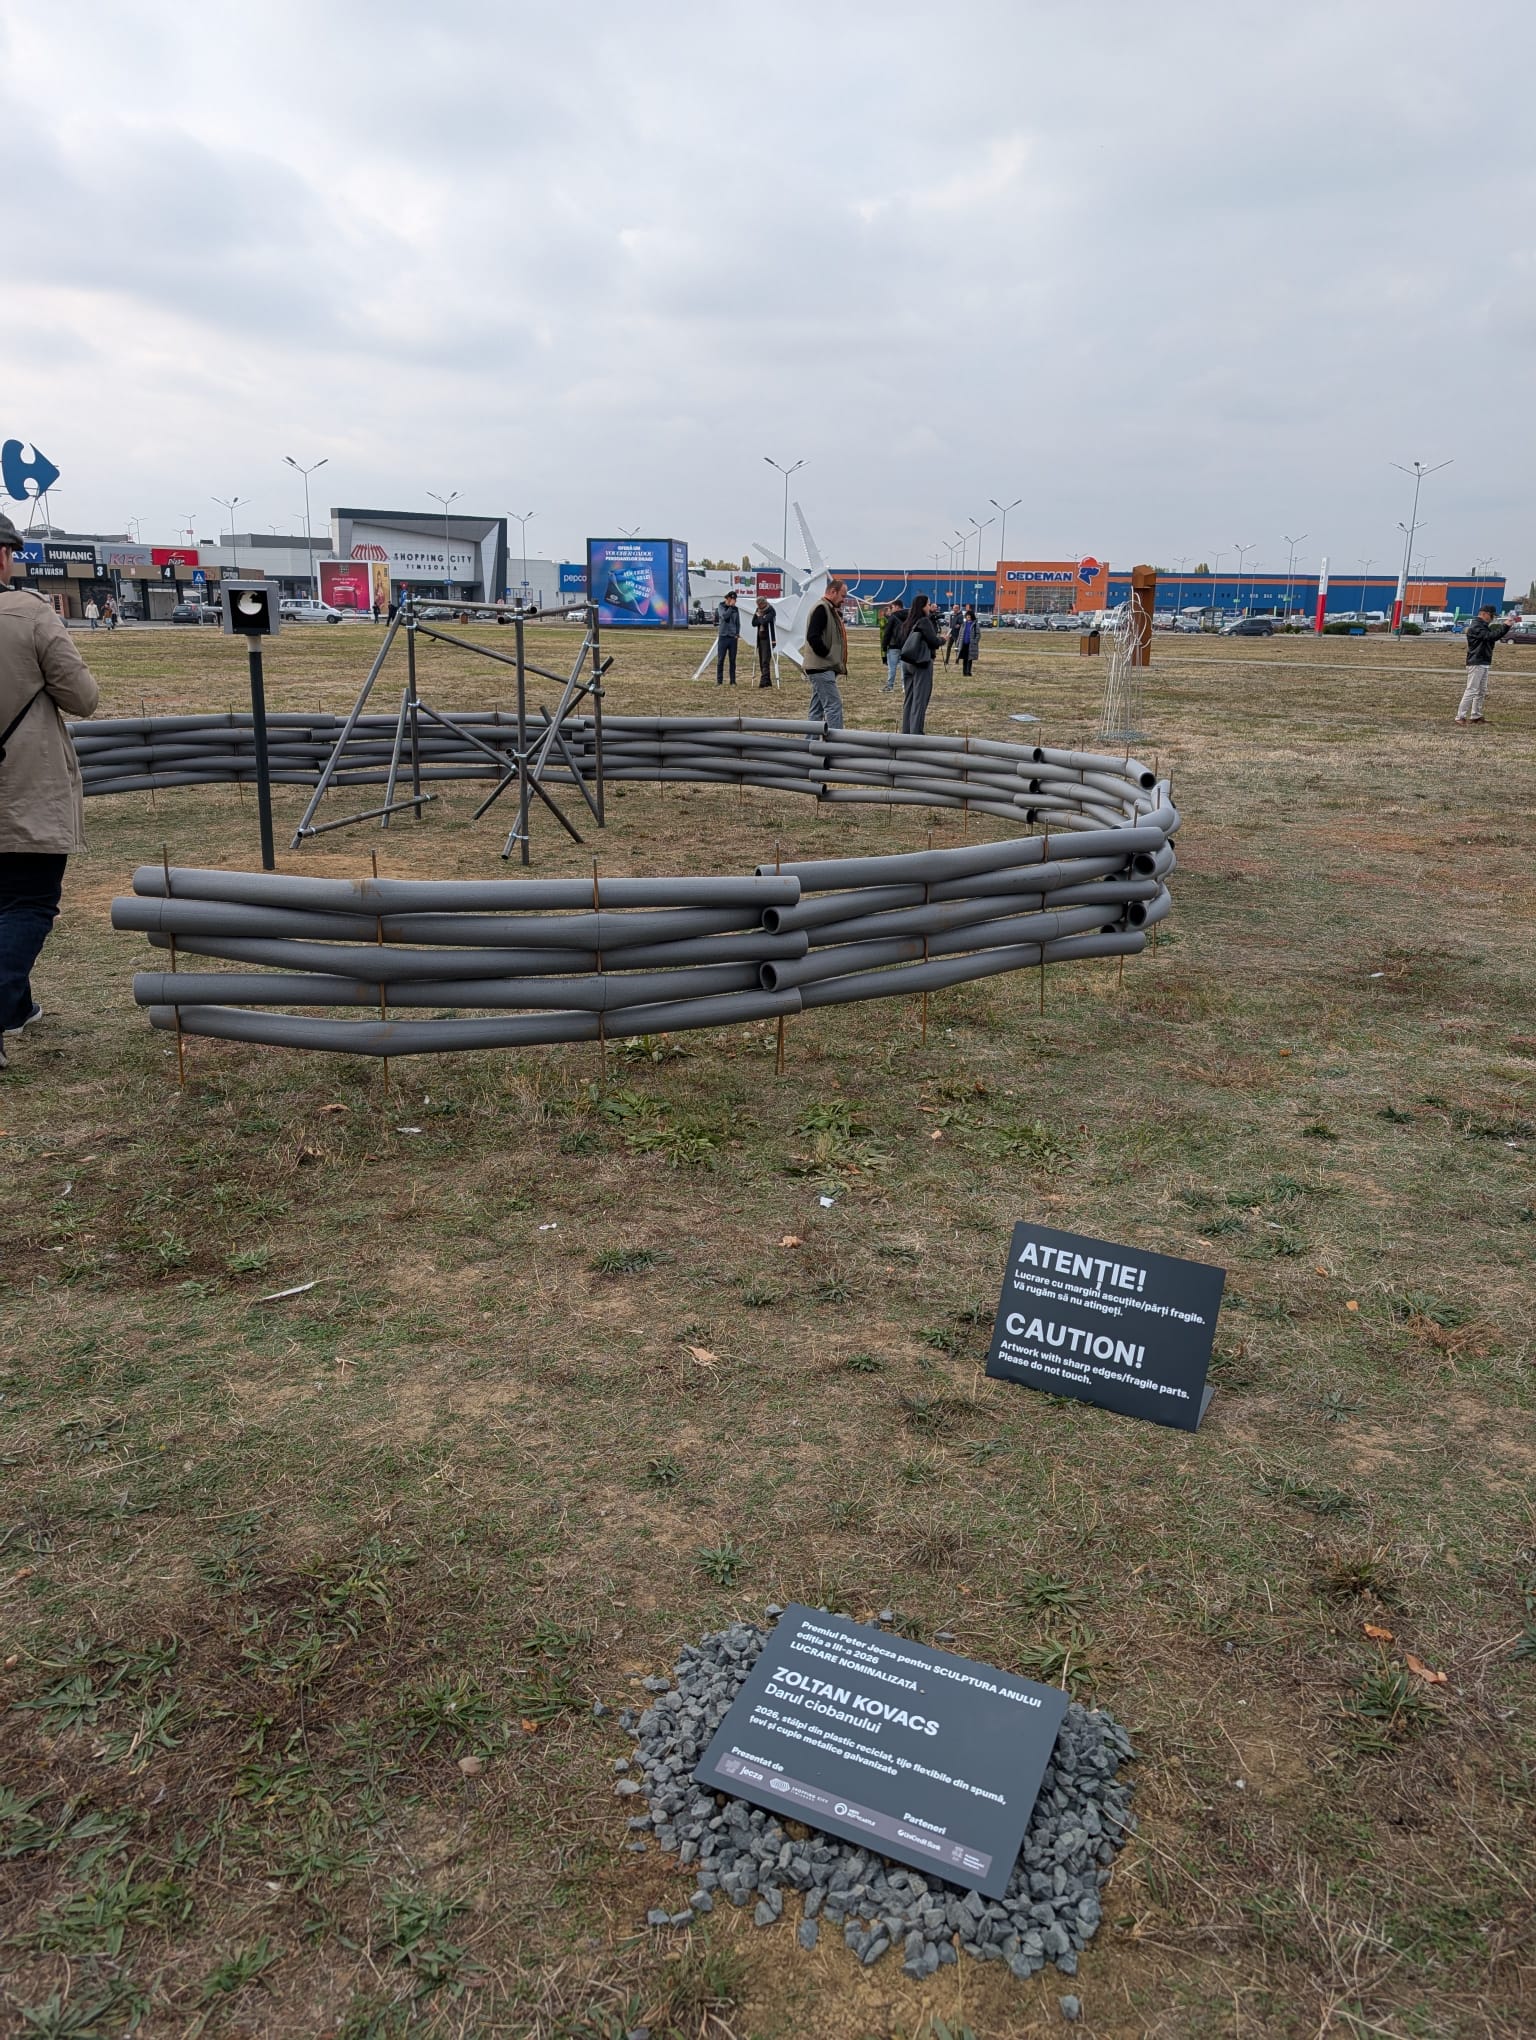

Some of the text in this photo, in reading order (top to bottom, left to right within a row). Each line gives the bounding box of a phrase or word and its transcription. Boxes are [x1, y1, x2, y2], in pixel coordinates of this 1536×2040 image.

[30, 567, 63, 576] CAR WASH
[49, 550, 93, 560] HUMANIC
[97, 566, 103, 576] 3
[164, 567, 170, 578] 4
[394, 553, 472, 564] SHOPPING CITY
[564, 574, 587, 583] pepco
[1006, 571, 1073, 581] DEDEMAN
[1018, 1242, 1147, 1292] ATENȚIE!
[1013, 1280, 1123, 1317] Vă rugăm să nu atingeți.
[1015, 1269, 1205, 1324] Lucrare cu margini ascuțite/părți fragile.
[1006, 1312, 1145, 1369] CAUTION!
[998, 1351, 1092, 1385] Please do not touch.
[1000, 1340, 1190, 1400] Artwork with sharp edges/fragile parts.
[797, 1631, 824, 1645] ediția
[832, 1643, 853, 1656] III-a
[853, 1650, 879, 1664] 2026
[801, 1621, 1042, 1708] Premiul Peter Jecza pentru SCULPTURA ANULUI
[790, 1641, 917, 1691] LUCRARE NOMINALIZATĂ
[765, 1683, 882, 1734] Darul ciobanului
[772, 1666, 940, 1736] ZOLTAN KOVACS
[731, 1746, 784, 1772] Prezentat de
[754, 1705, 780, 1721] 2026,
[808, 1725, 823, 1735] din
[823, 1730, 855, 1748] plastic
[856, 1743, 894, 1763] reciclat,
[896, 1757, 912, 1769] tije
[913, 1764, 952, 1784] flexibile
[953, 1777, 970, 1790] din
[970, 1785, 1006, 1805] spumă,
[776, 1725, 802, 1740] cuple
[803, 1734, 843, 1755] metalice
[843, 1750, 898, 1776] galvanizate
[903, 1813, 947, 1835] Parteneri
